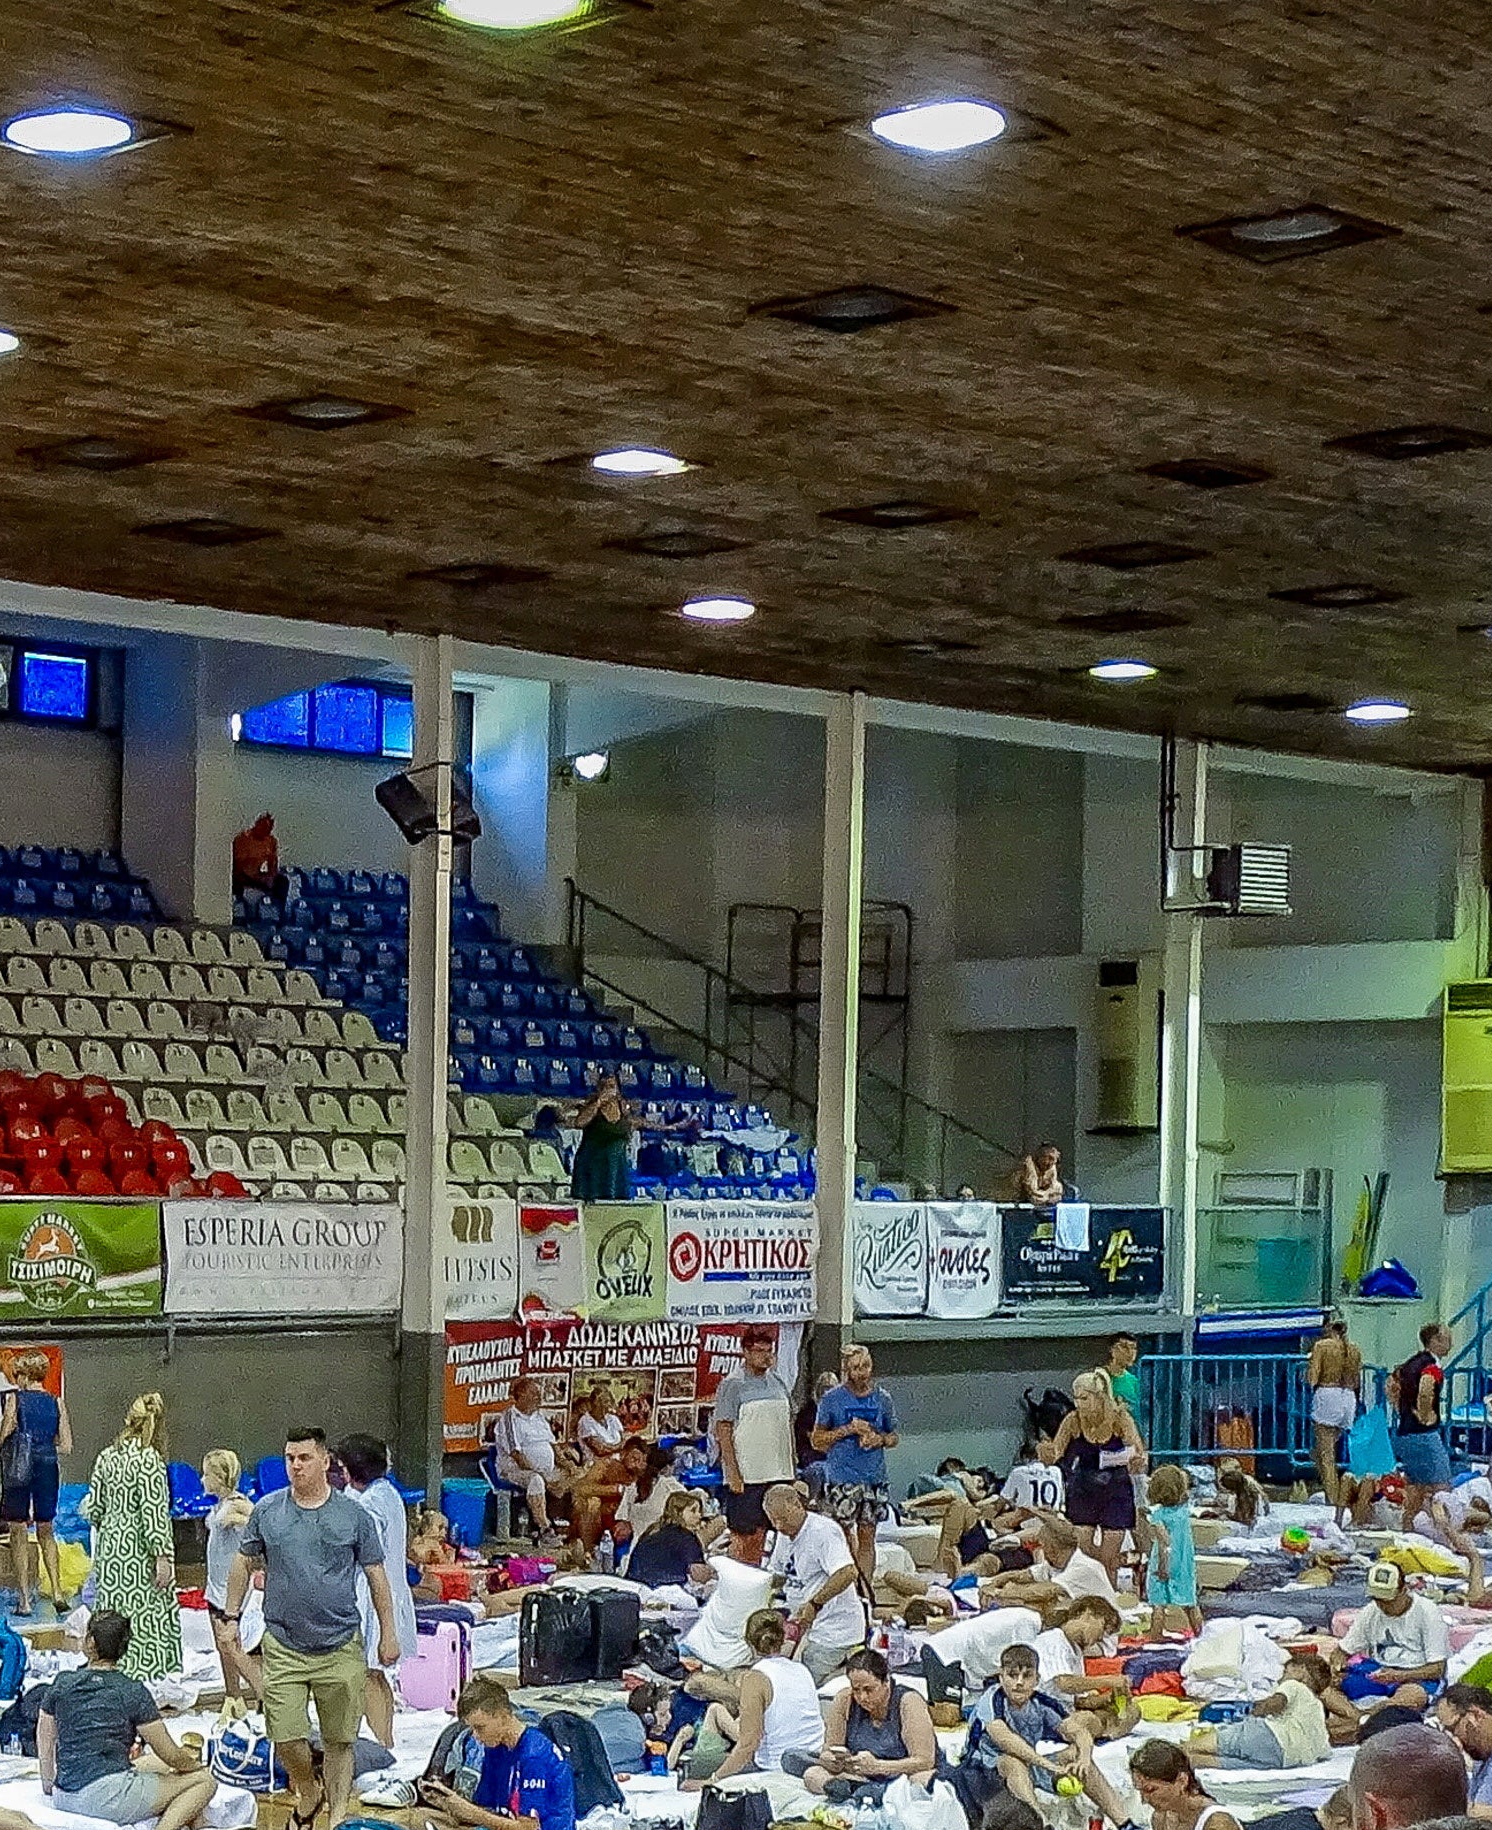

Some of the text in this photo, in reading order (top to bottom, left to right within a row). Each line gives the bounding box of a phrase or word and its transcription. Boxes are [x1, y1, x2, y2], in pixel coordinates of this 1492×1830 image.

[184, 1217, 387, 1248] ESPERIA GROUP
[757, 1228, 813, 1237] MARKET
[703, 1238, 813, 1270] ΚΡΗΤΙΚΟΣ
[10, 1259, 94, 1283] ΤΣΙΣΙΜΟΙΡΗ
[567, 1323, 701, 1349] ΔΩΔΕΚΑΝΗΣΟΣ
[527, 1349, 601, 1369] ΜΠΑΣΚΕΤ
[604, 1350, 629, 1367] ΜΕ
[631, 1347, 699, 1366] ΑΜΑΞΙΔΙΟ
[1028, 1479, 1059, 1508] 10
